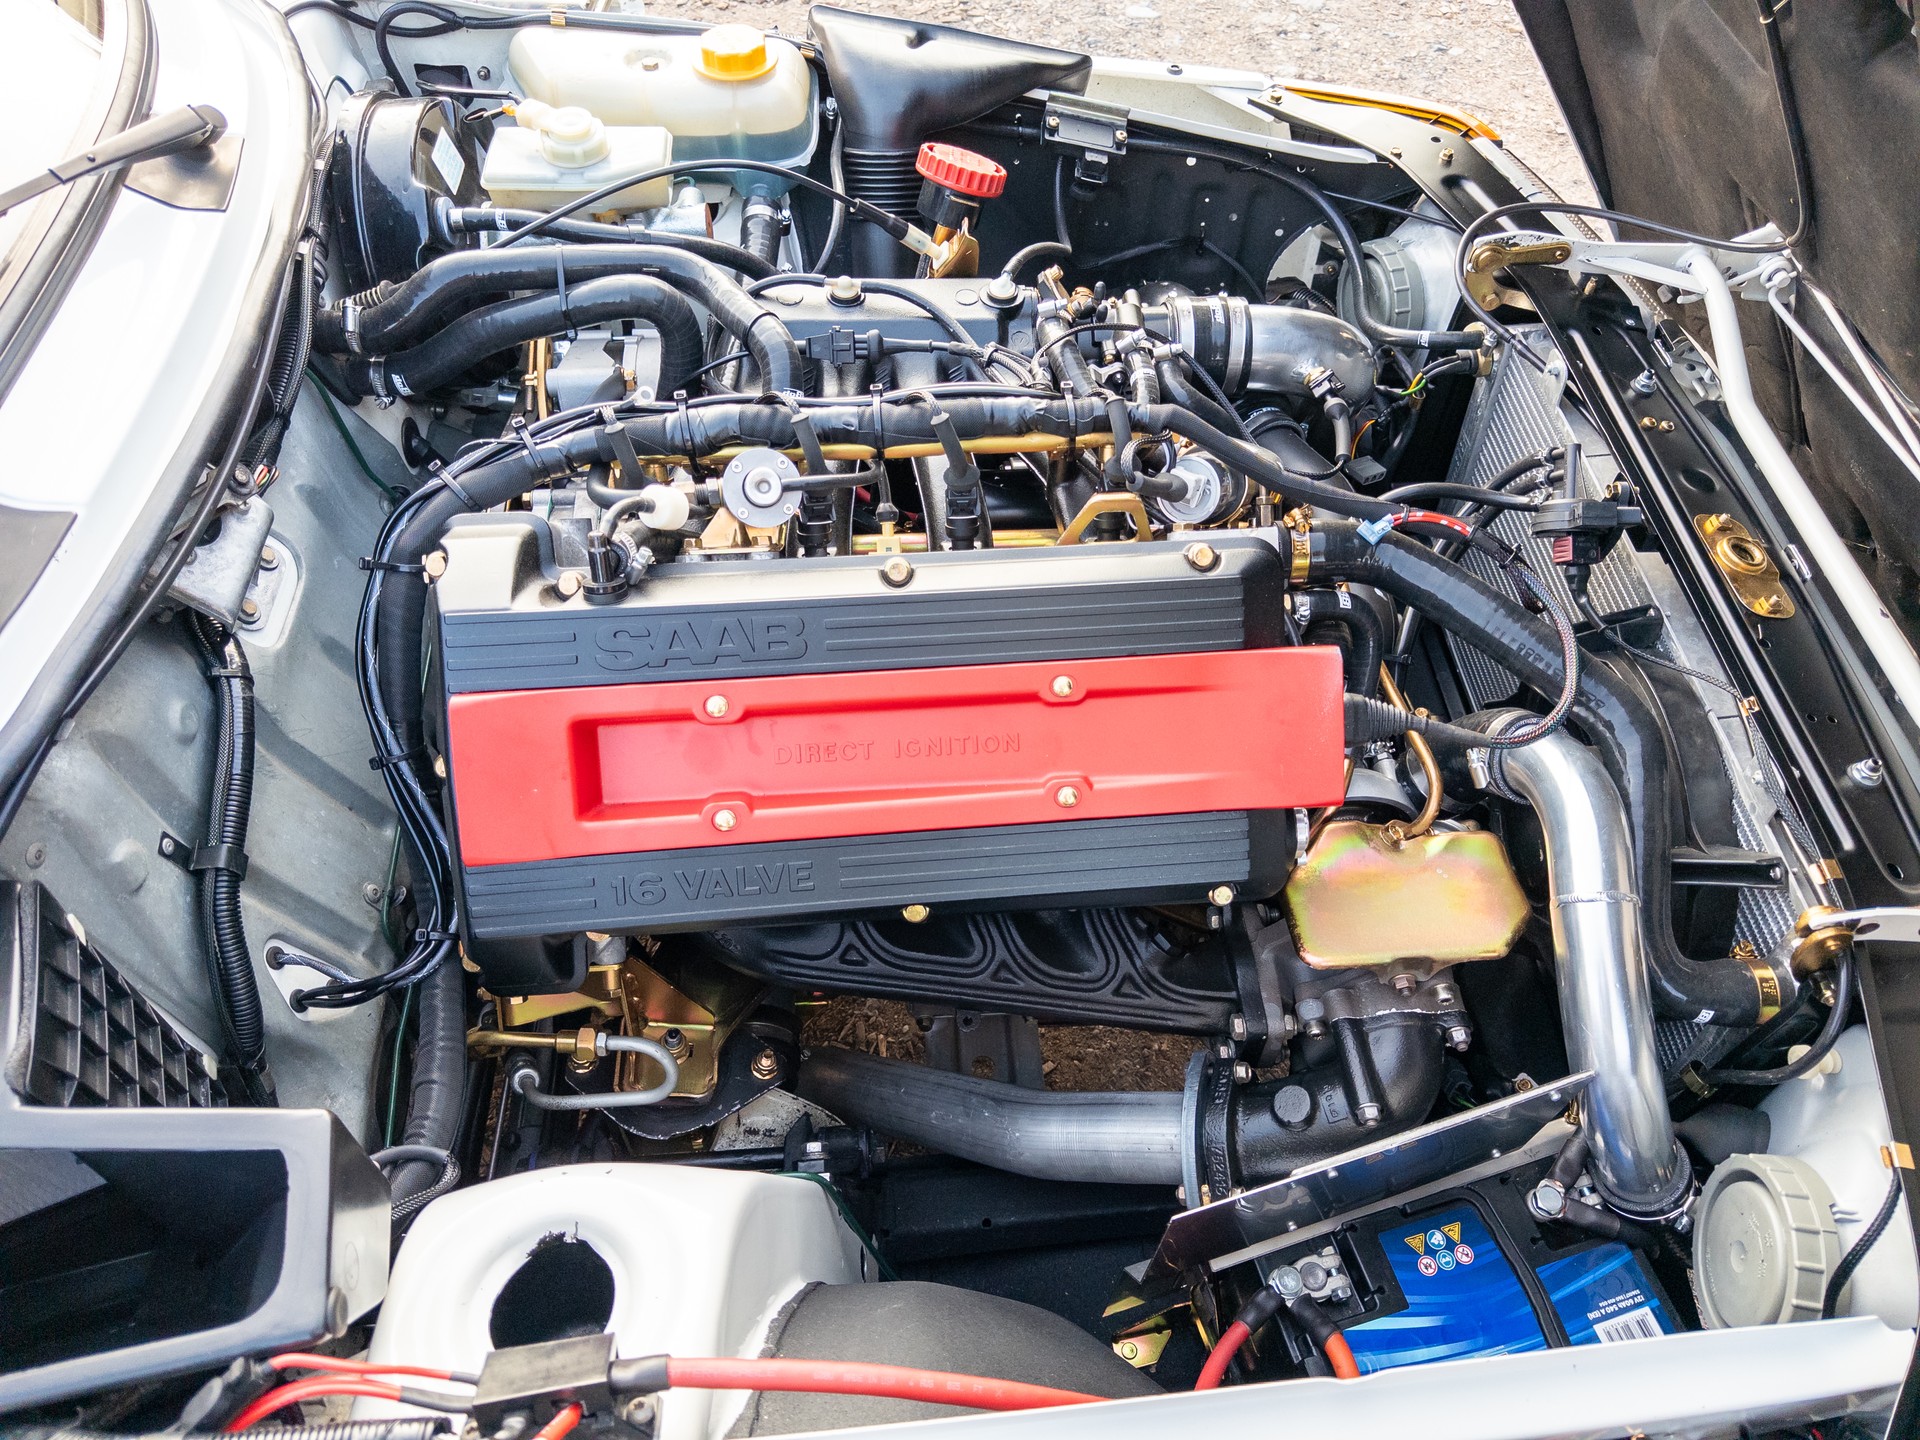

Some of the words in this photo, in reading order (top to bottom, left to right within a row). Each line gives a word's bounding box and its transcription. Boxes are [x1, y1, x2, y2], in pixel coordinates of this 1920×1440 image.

[595, 614, 808, 672] SAAB
[774, 741, 874, 767] DIRECT
[894, 732, 1022, 758] IGNITION
[612, 874, 667, 907] 16
[674, 861, 816, 900] VALVE
[1618, 1299, 1633, 1309] 60Ah
[1633, 1295, 1645, 1304] 12V
[1600, 1307, 1606, 1316] A
[1606, 1303, 1617, 1313] 540
